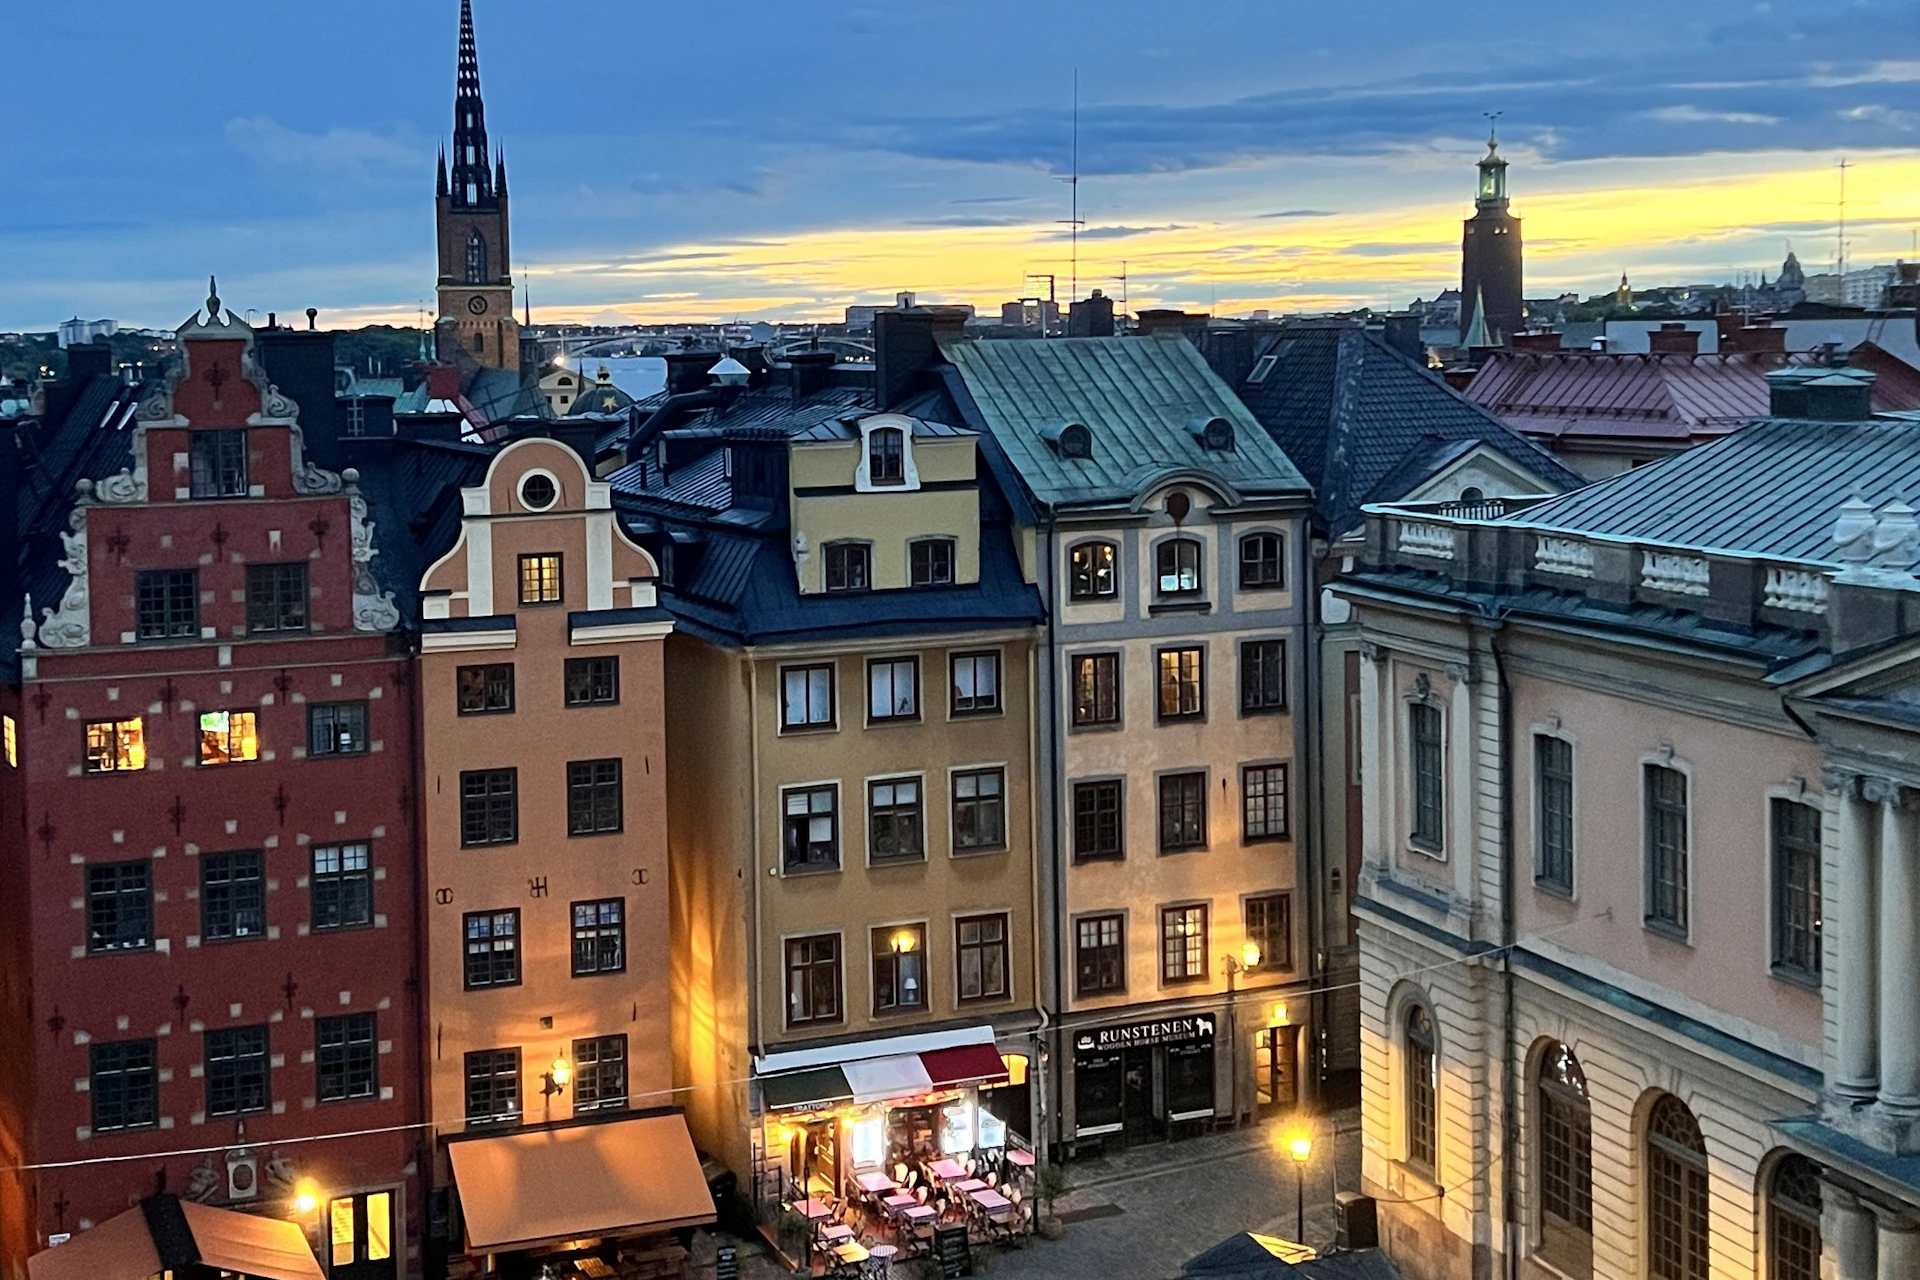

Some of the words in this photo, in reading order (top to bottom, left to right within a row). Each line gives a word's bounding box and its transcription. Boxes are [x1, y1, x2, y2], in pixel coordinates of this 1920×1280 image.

[1097, 1040, 1132, 1051] WOODEN
[1134, 1036, 1160, 1047] HORSE
[1162, 1031, 1196, 1043] MUSEUM
[1100, 1019, 1193, 1043] RUNSTENEN
[793, 1101, 834, 1112] TRATTORIA
